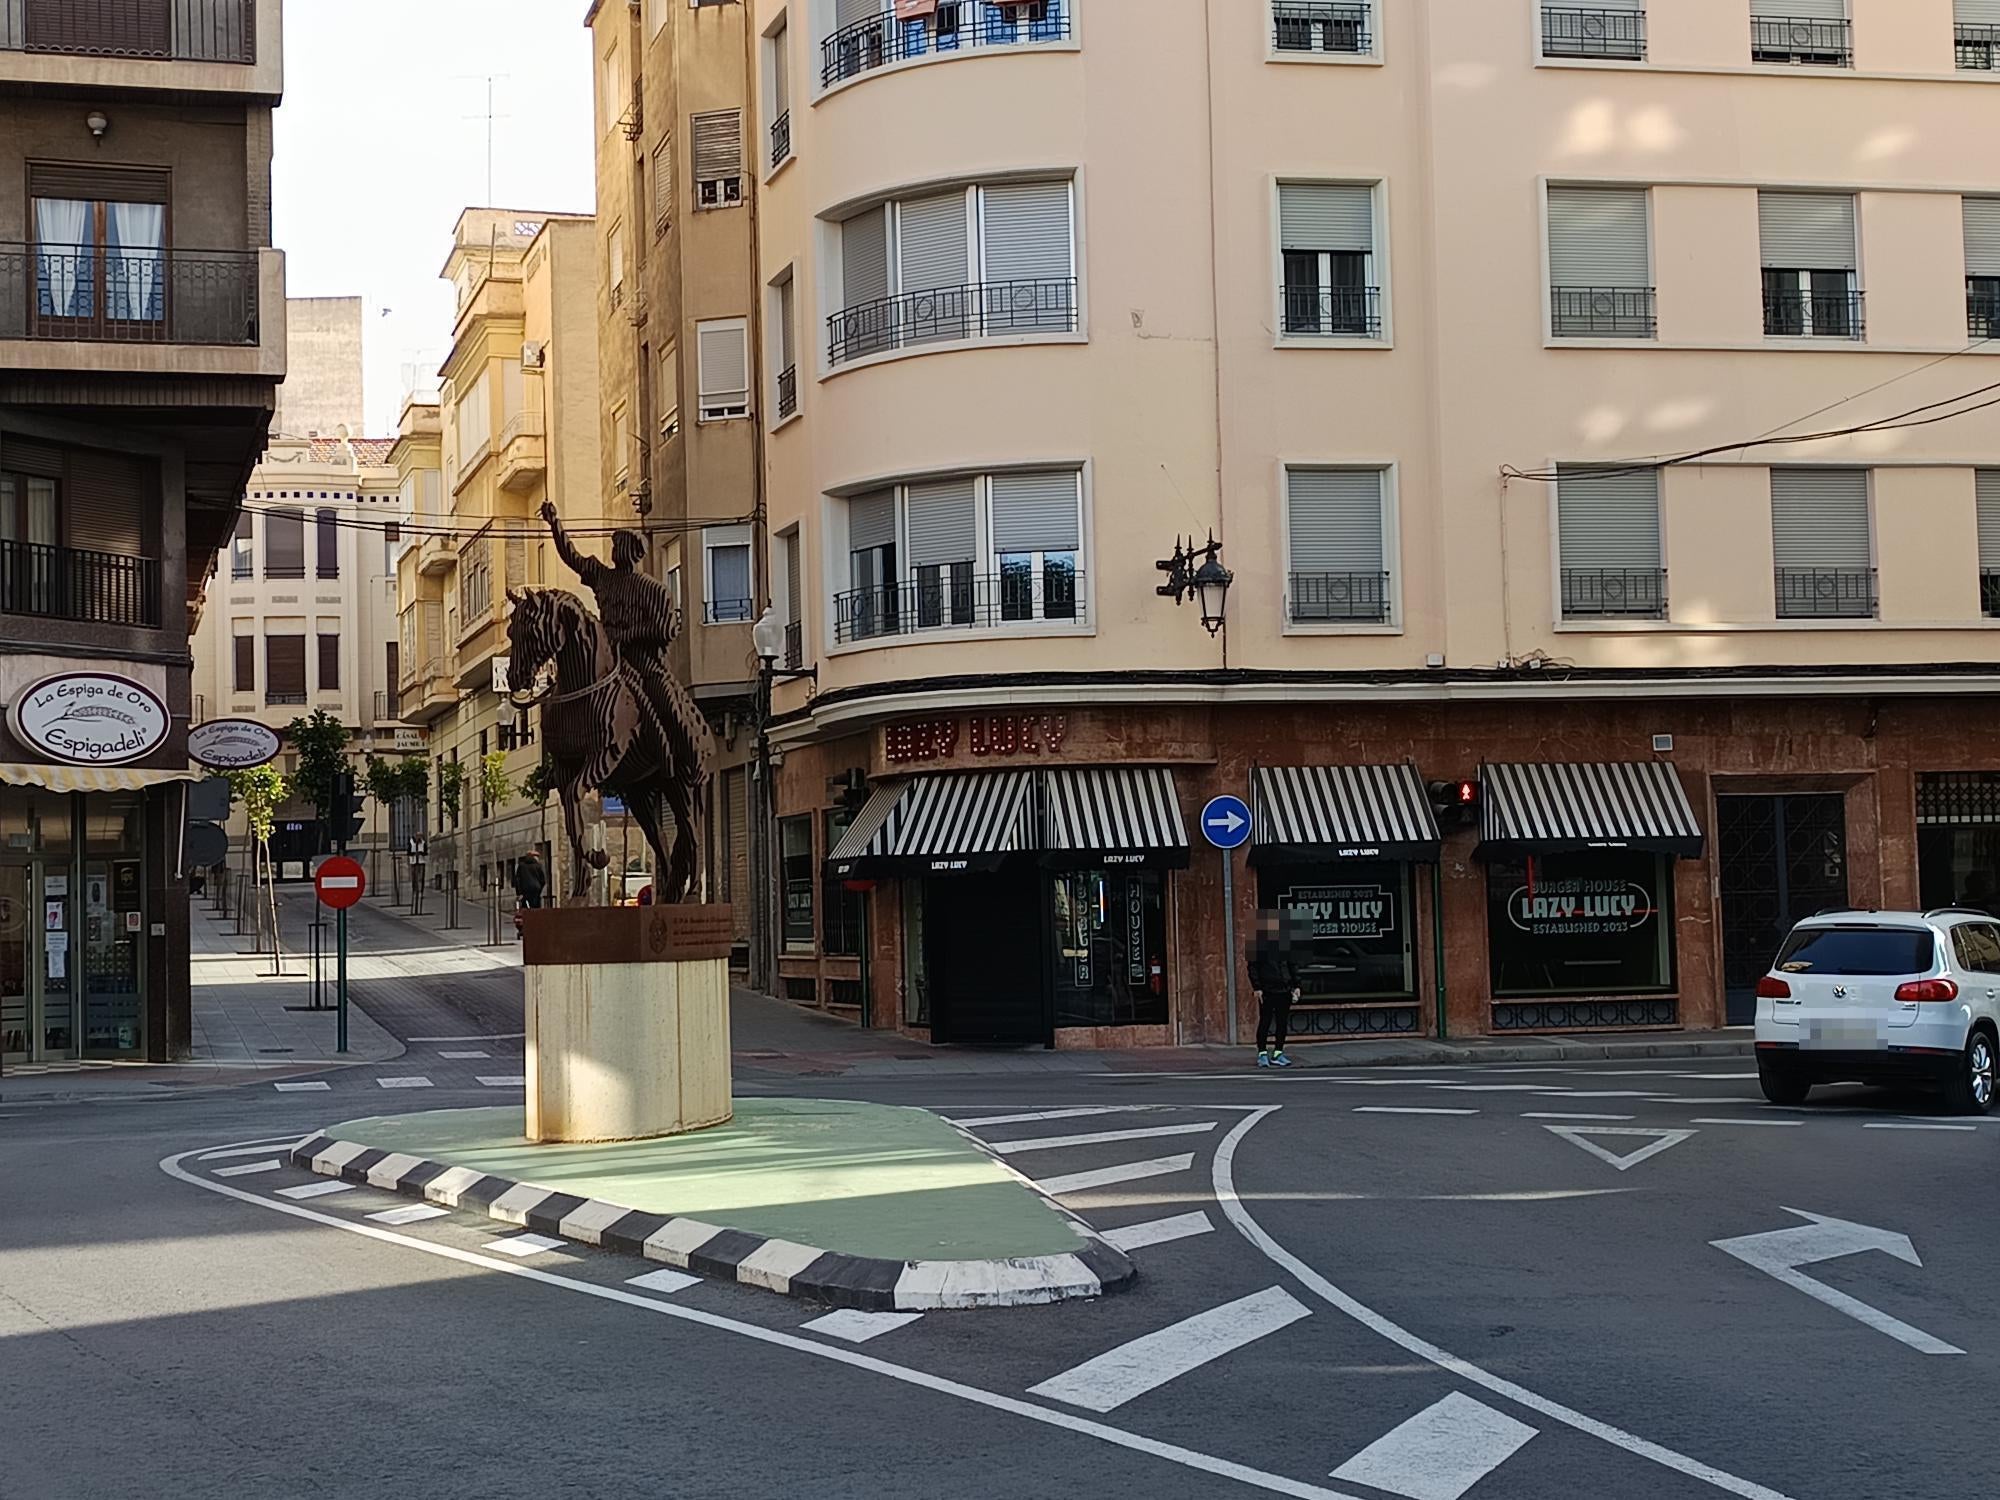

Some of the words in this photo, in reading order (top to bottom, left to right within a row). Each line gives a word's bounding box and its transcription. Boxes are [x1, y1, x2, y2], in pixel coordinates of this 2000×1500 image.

[34, 694, 54, 708] La
[57, 683, 103, 698] Espiga
[107, 685, 124, 699] de
[127, 692, 151, 713] Oro
[193, 731, 207, 740] La
[208, 724, 239, 733] Espiga
[254, 728, 271, 740] Oro
[971, 715, 1067, 757] LUCY
[45, 728, 146, 759] Espigadeli
[200, 748, 267, 766] Espigadeli
[931, 861, 949, 870] LAZY
[950, 860, 968, 869] LUCY
[1103, 855, 1123, 863] LAZY
[1125, 854, 1145, 863] LUCY
[1532, 880, 1580, 894] BURGER
[1584, 880, 1627, 893] HOUSE
[1339, 901, 1383, 919] LUCY
[1521, 896, 1576, 918] LAZY
[1583, 895, 1636, 917] LUCY
[1129, 883, 1141, 960] HOUSE
[1341, 922, 1377, 933] HOUSE
[1533, 922, 1600, 934] ESTABLISHED
[1077, 883, 1089, 980] BURGR
